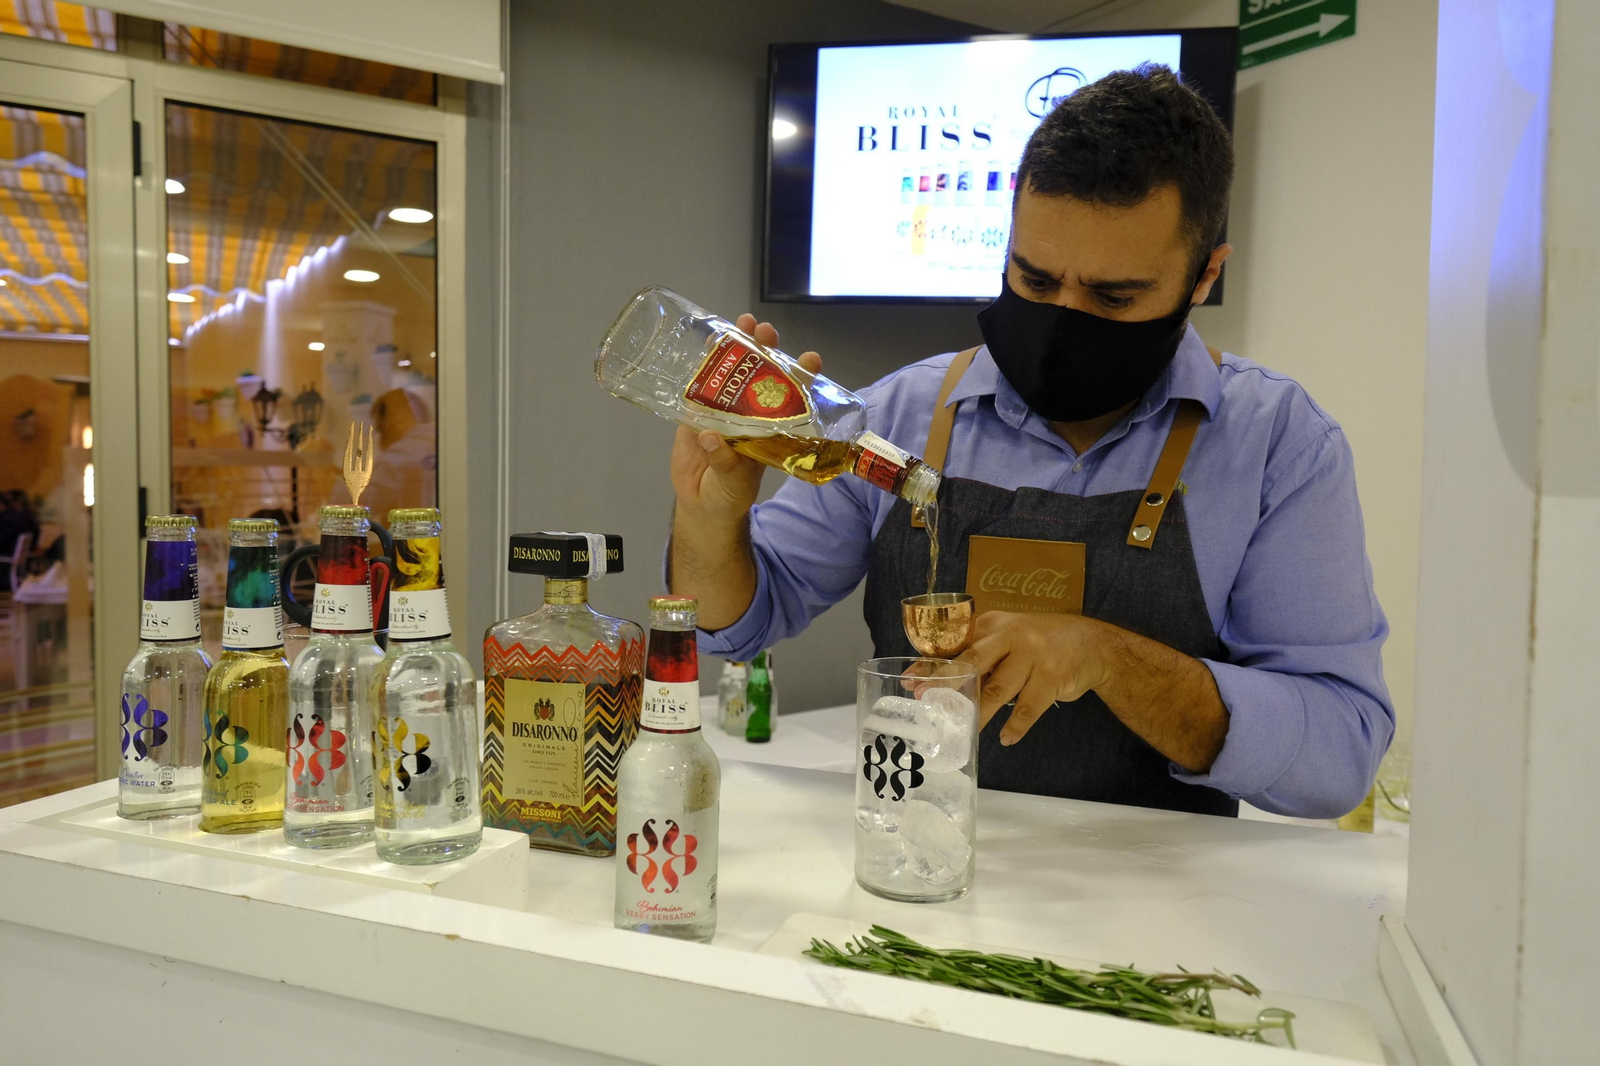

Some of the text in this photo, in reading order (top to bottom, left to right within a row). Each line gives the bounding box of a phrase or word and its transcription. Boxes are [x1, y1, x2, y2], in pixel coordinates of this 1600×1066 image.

[888, 105, 962, 120] ROYAL
[857, 123, 992, 151] BLISS
[710, 353, 737, 388] AÑEJO
[717, 353, 760, 408] CACIQUE
[513, 547, 561, 561] DISARONNO
[980, 564, 1071, 600] Coca-Cola
[645, 702, 686, 714] BLISS
[512, 722, 578, 742] DISARONNO
[522, 743, 566, 751] ORIGINALE
[130, 780, 156, 788] WATER
[520, 807, 561, 819] MISSONI
[636, 900, 683, 913] Bohemian
[625, 909, 697, 921] BERRY SENSATION
